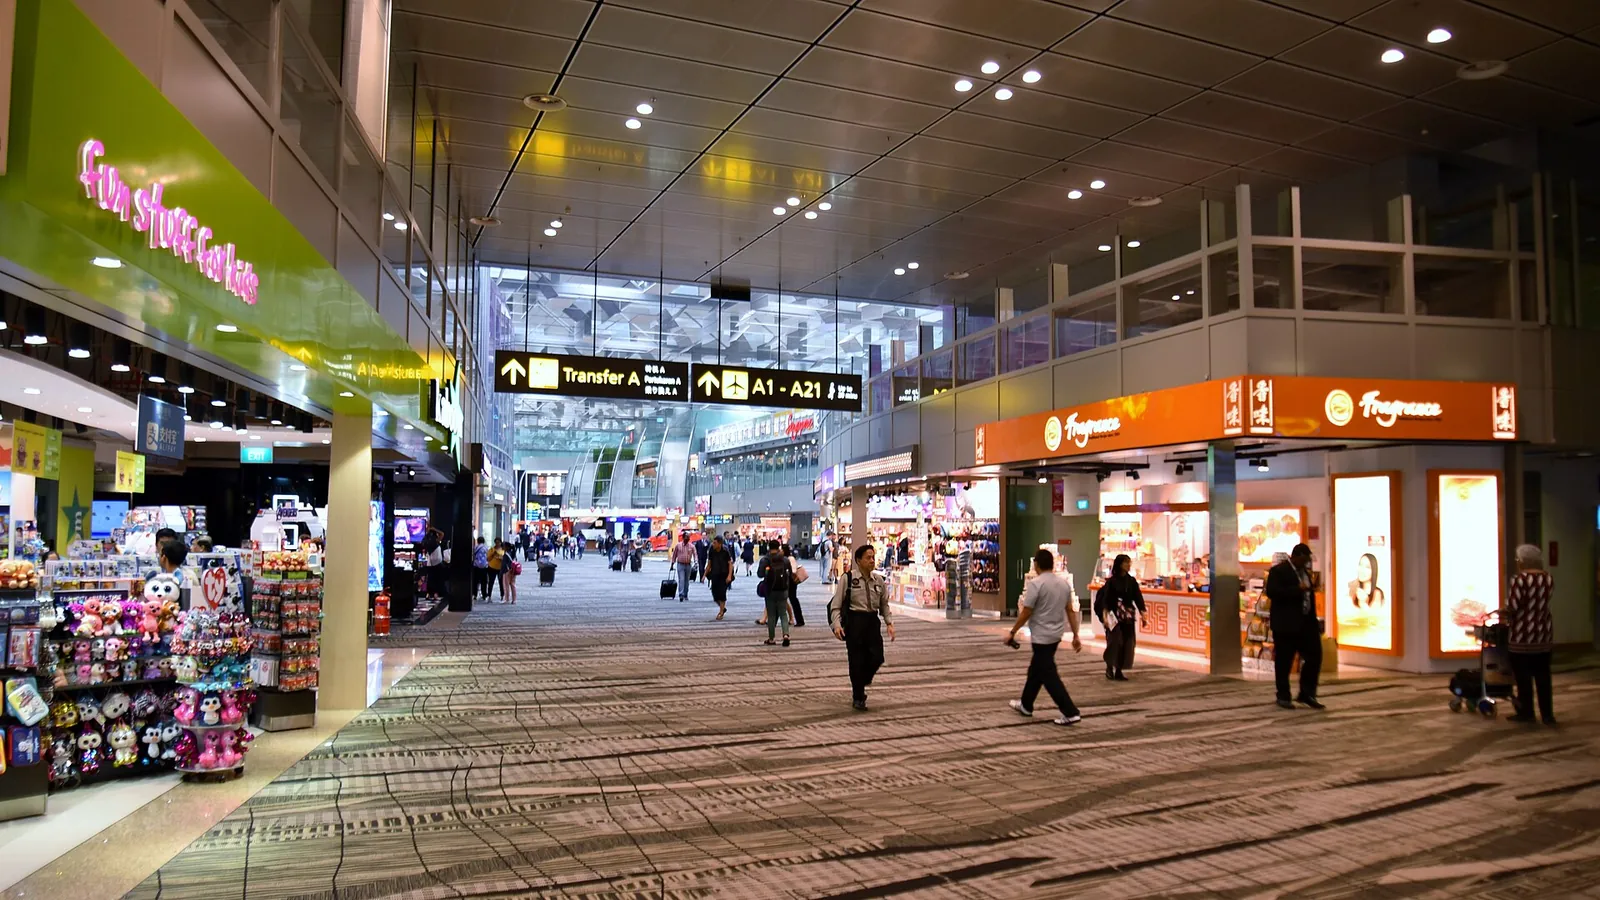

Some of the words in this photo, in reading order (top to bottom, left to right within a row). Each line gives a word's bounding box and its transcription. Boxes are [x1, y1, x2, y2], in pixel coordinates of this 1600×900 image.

[79, 138, 131, 221] fun
[132, 182, 199, 264] stuff
[196, 226, 226, 283] for
[224, 243, 260, 305] kids
[562, 366, 624, 386] Transfer
[627, 371, 641, 387] A
[752, 378, 774, 396] A1
[790, 381, 821, 399] A21
[1226, 381, 1241, 427] 香味
[1252, 379, 1271, 426] 香味
[1358, 389, 1443, 428] Fragrance
[1064, 412, 1121, 448] Fragrance
[247, 452, 265, 461] EXIT
